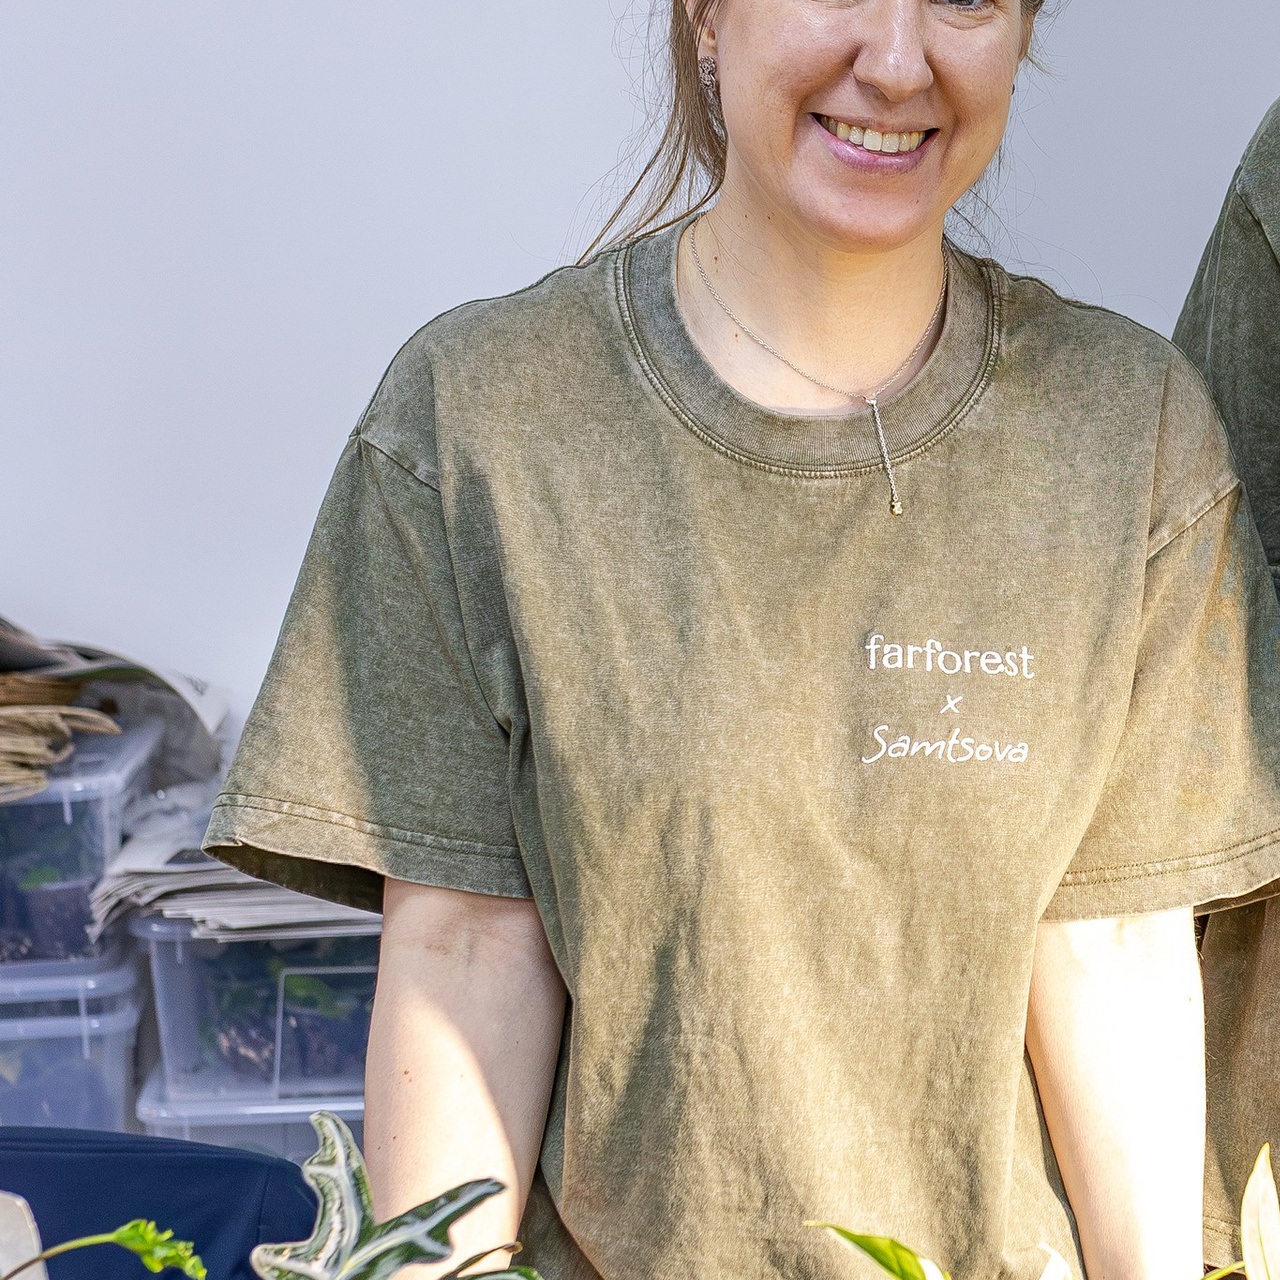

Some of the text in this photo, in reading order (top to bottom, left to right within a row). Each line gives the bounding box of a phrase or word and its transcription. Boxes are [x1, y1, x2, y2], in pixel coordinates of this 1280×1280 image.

[865, 634, 1035, 679] farforest
[939, 694, 963, 714] x
[861, 724, 1030, 763] Samtsova
